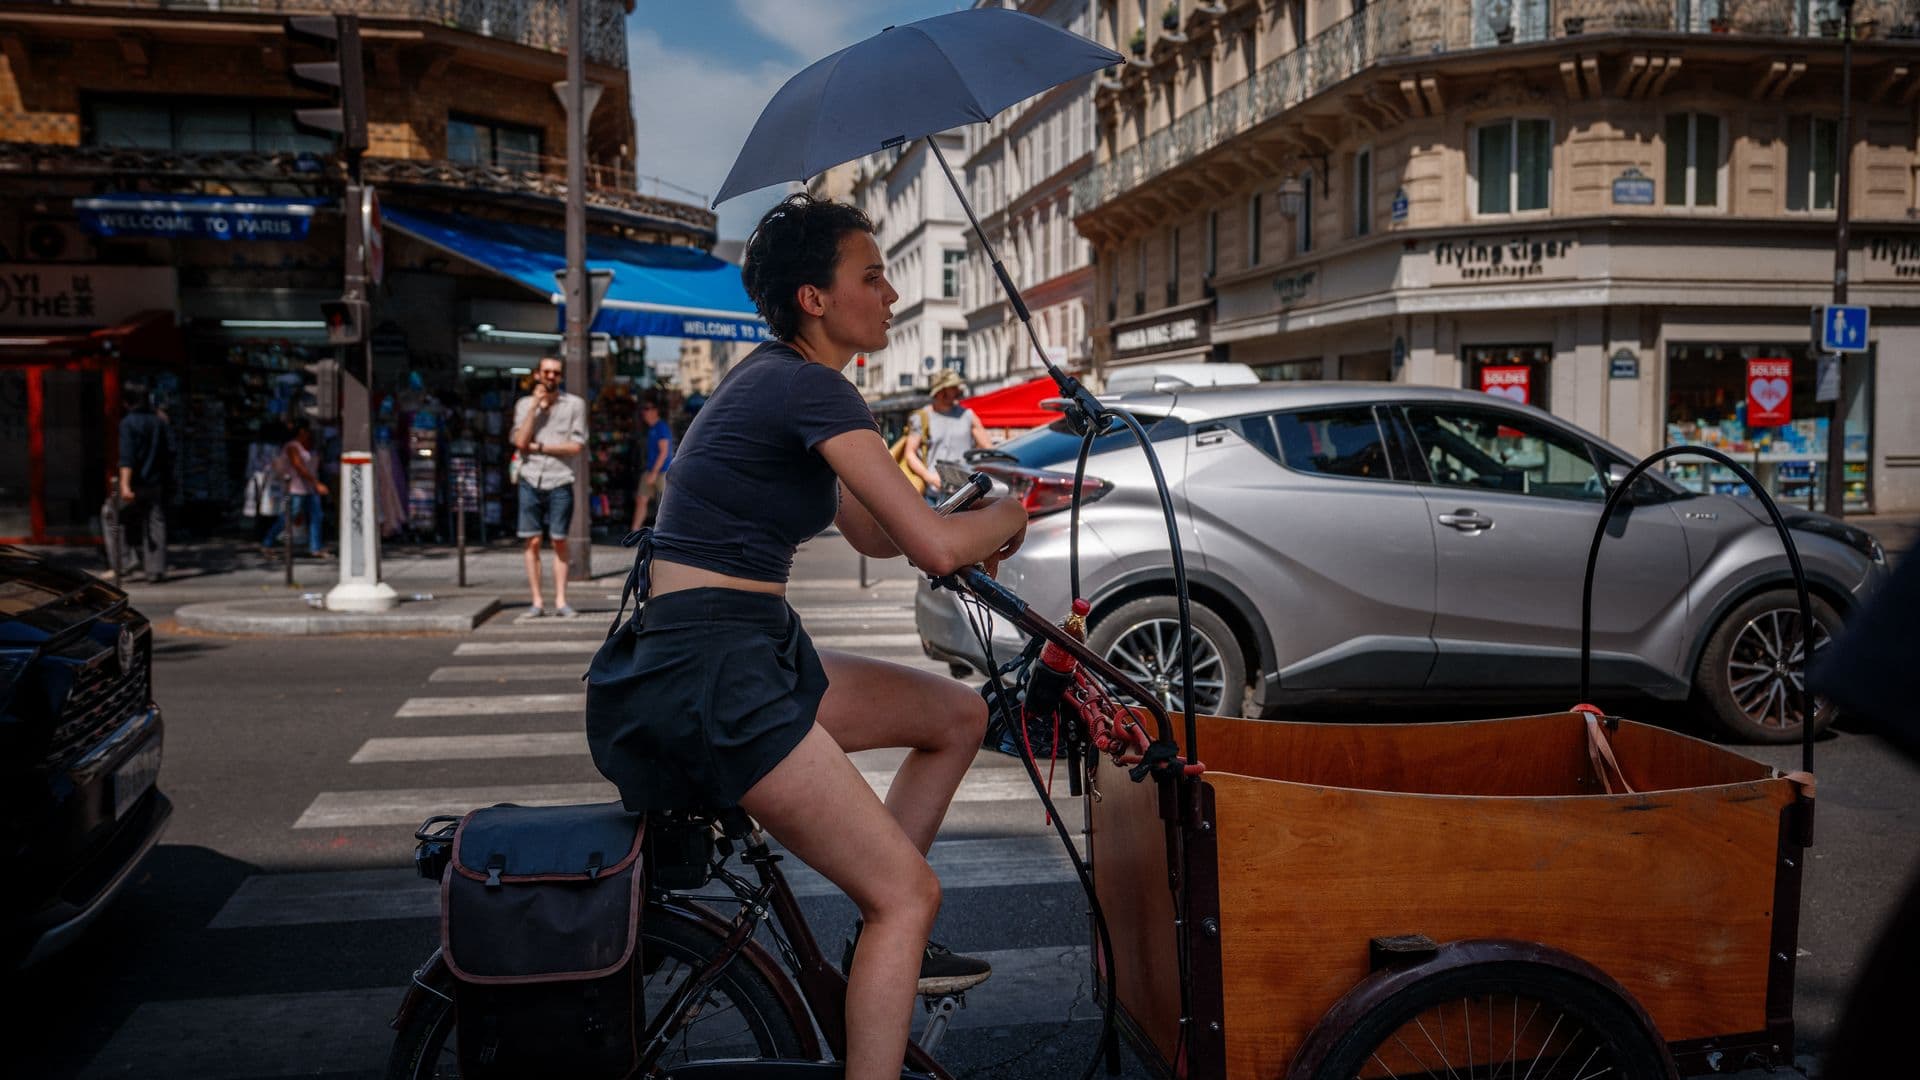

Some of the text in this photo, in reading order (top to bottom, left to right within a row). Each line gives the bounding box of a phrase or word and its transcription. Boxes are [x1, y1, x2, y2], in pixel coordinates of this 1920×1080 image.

[99, 213, 291, 234] WELCOME TO PARIS
[12, 272, 39, 293] YI
[15, 290, 71, 317] THÉ
[683, 320, 737, 338] WELCOME
[740, 324, 756, 339] TO
[1484, 370, 1527, 385] SOLDES
[1750, 363, 1790, 377] SOLDES
